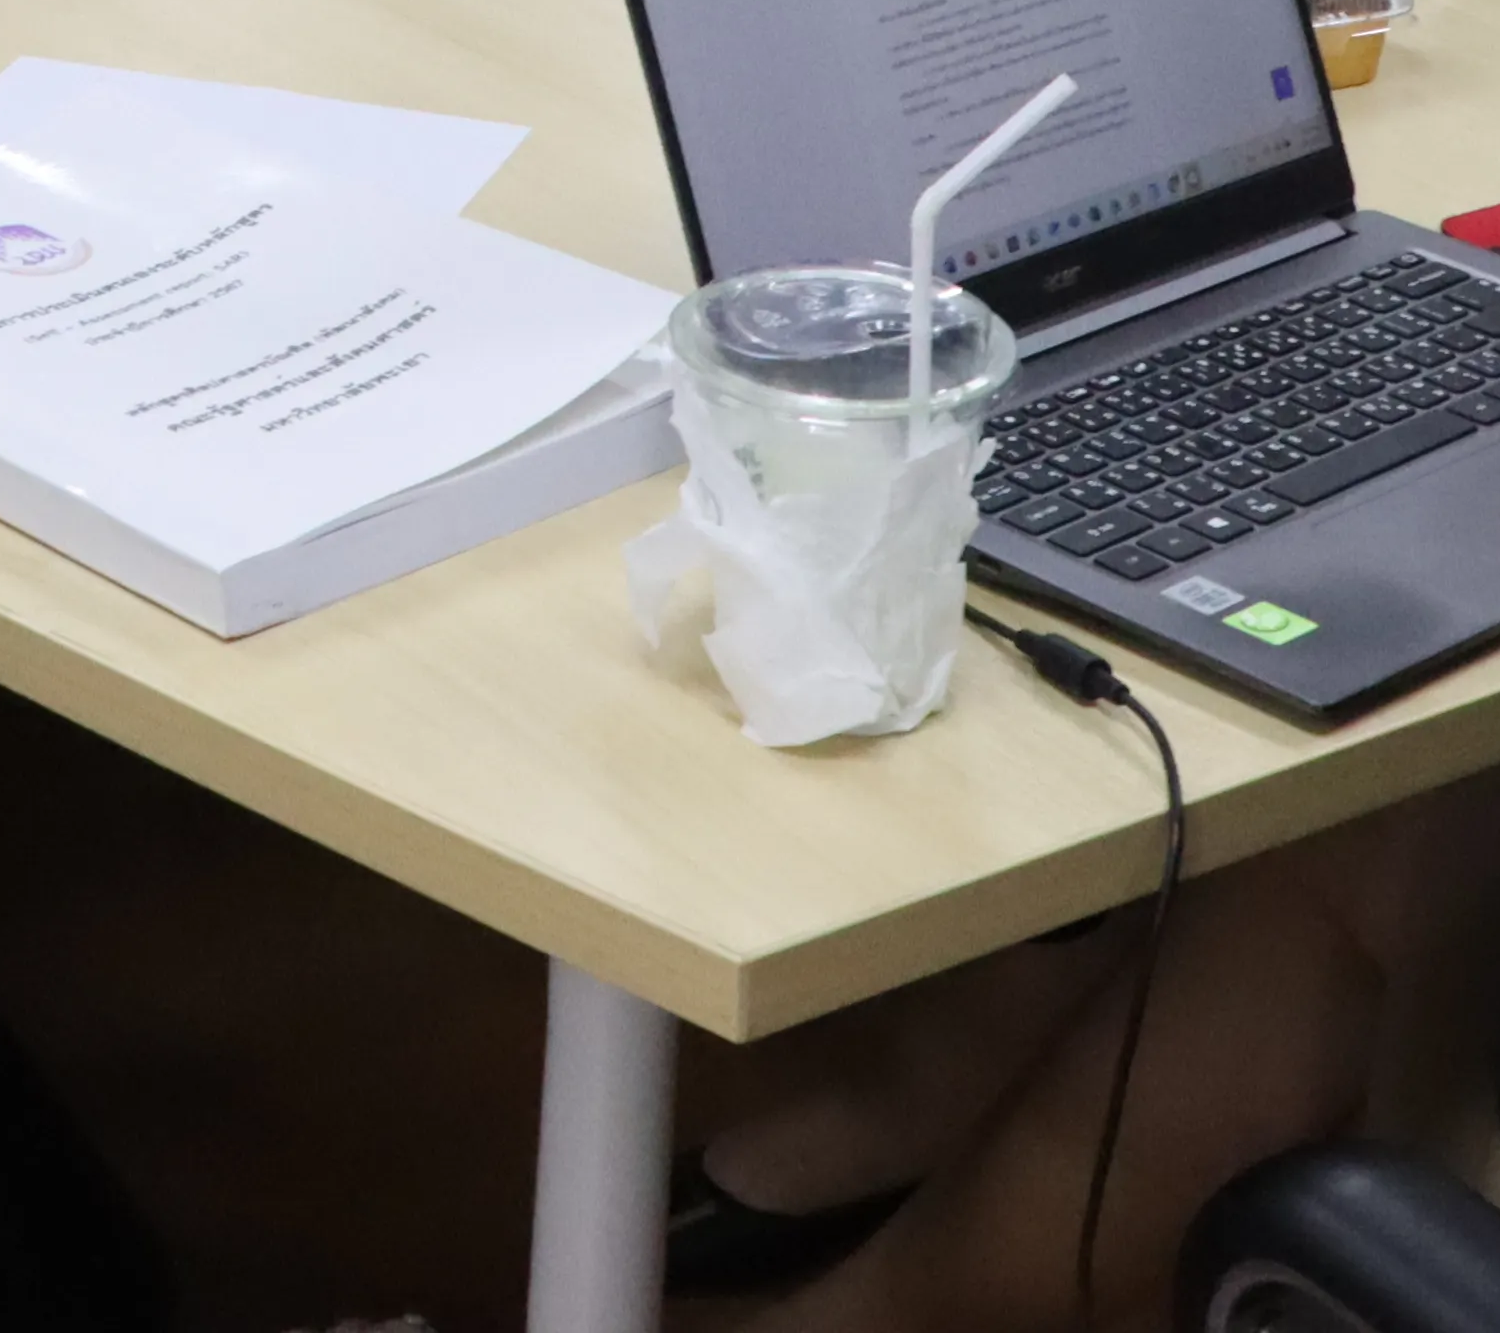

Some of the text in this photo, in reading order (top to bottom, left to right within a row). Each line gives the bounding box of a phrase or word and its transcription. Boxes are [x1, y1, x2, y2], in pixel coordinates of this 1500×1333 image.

[166, 299, 437, 432] คณะรัฐศาสตร์และสังคมศาสตร์
[260, 351, 430, 432] มหาวิทยาลัยพะเยา
